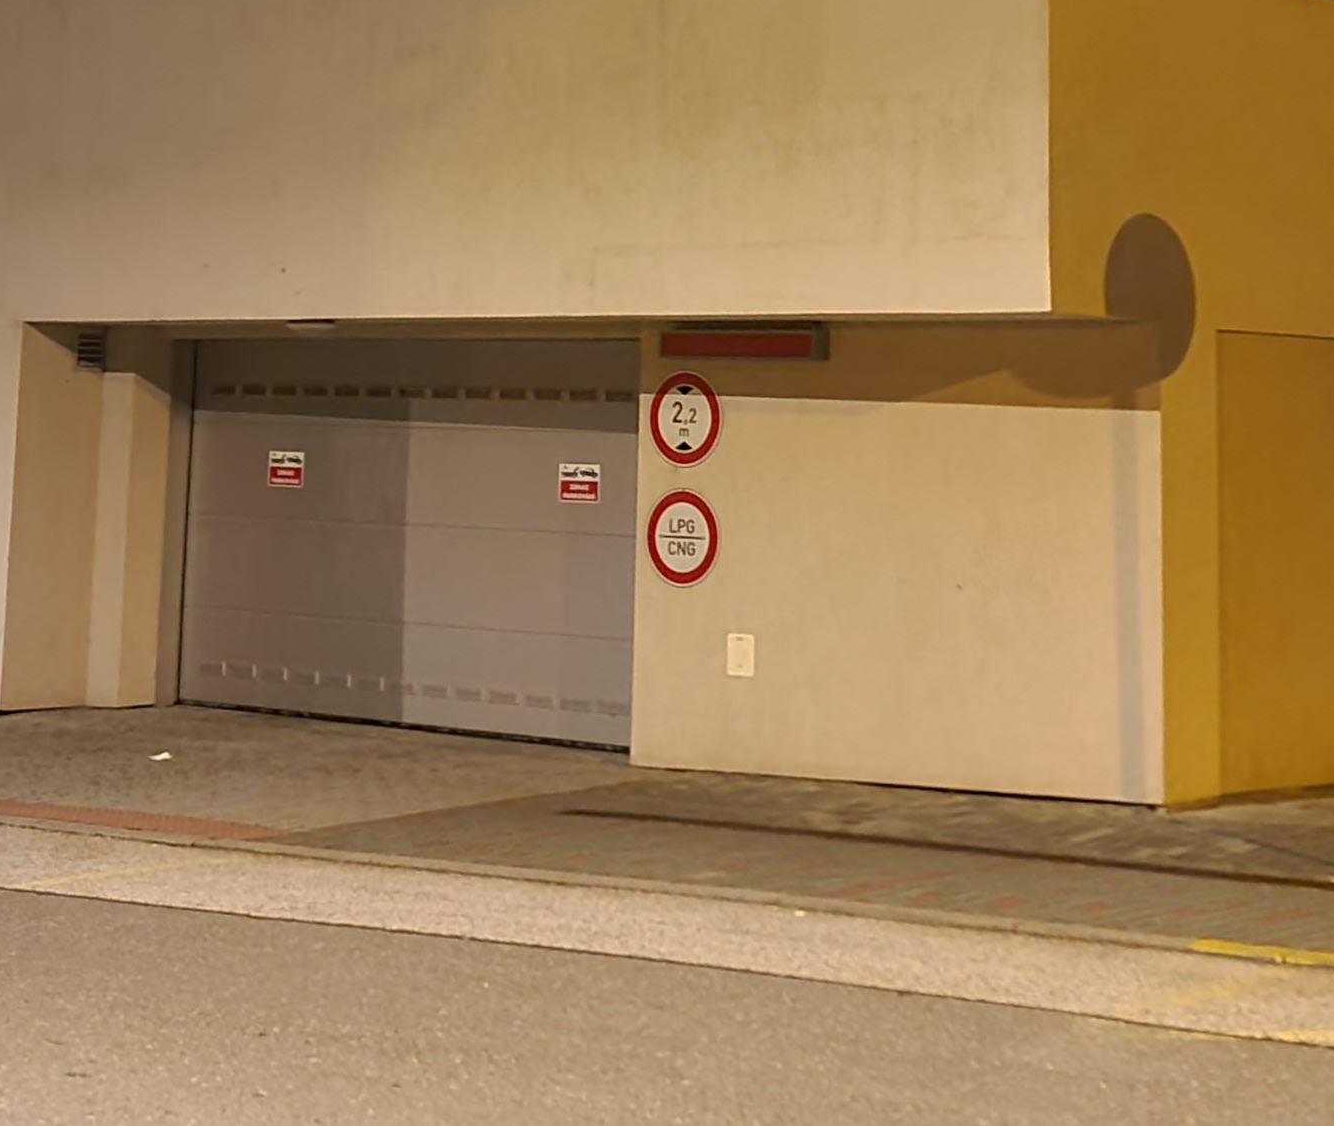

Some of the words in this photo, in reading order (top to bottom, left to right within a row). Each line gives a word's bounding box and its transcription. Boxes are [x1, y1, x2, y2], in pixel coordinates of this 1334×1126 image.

[678, 427, 690, 437] m
[668, 519, 695, 534] LPG
[667, 541, 696, 557] CNG
